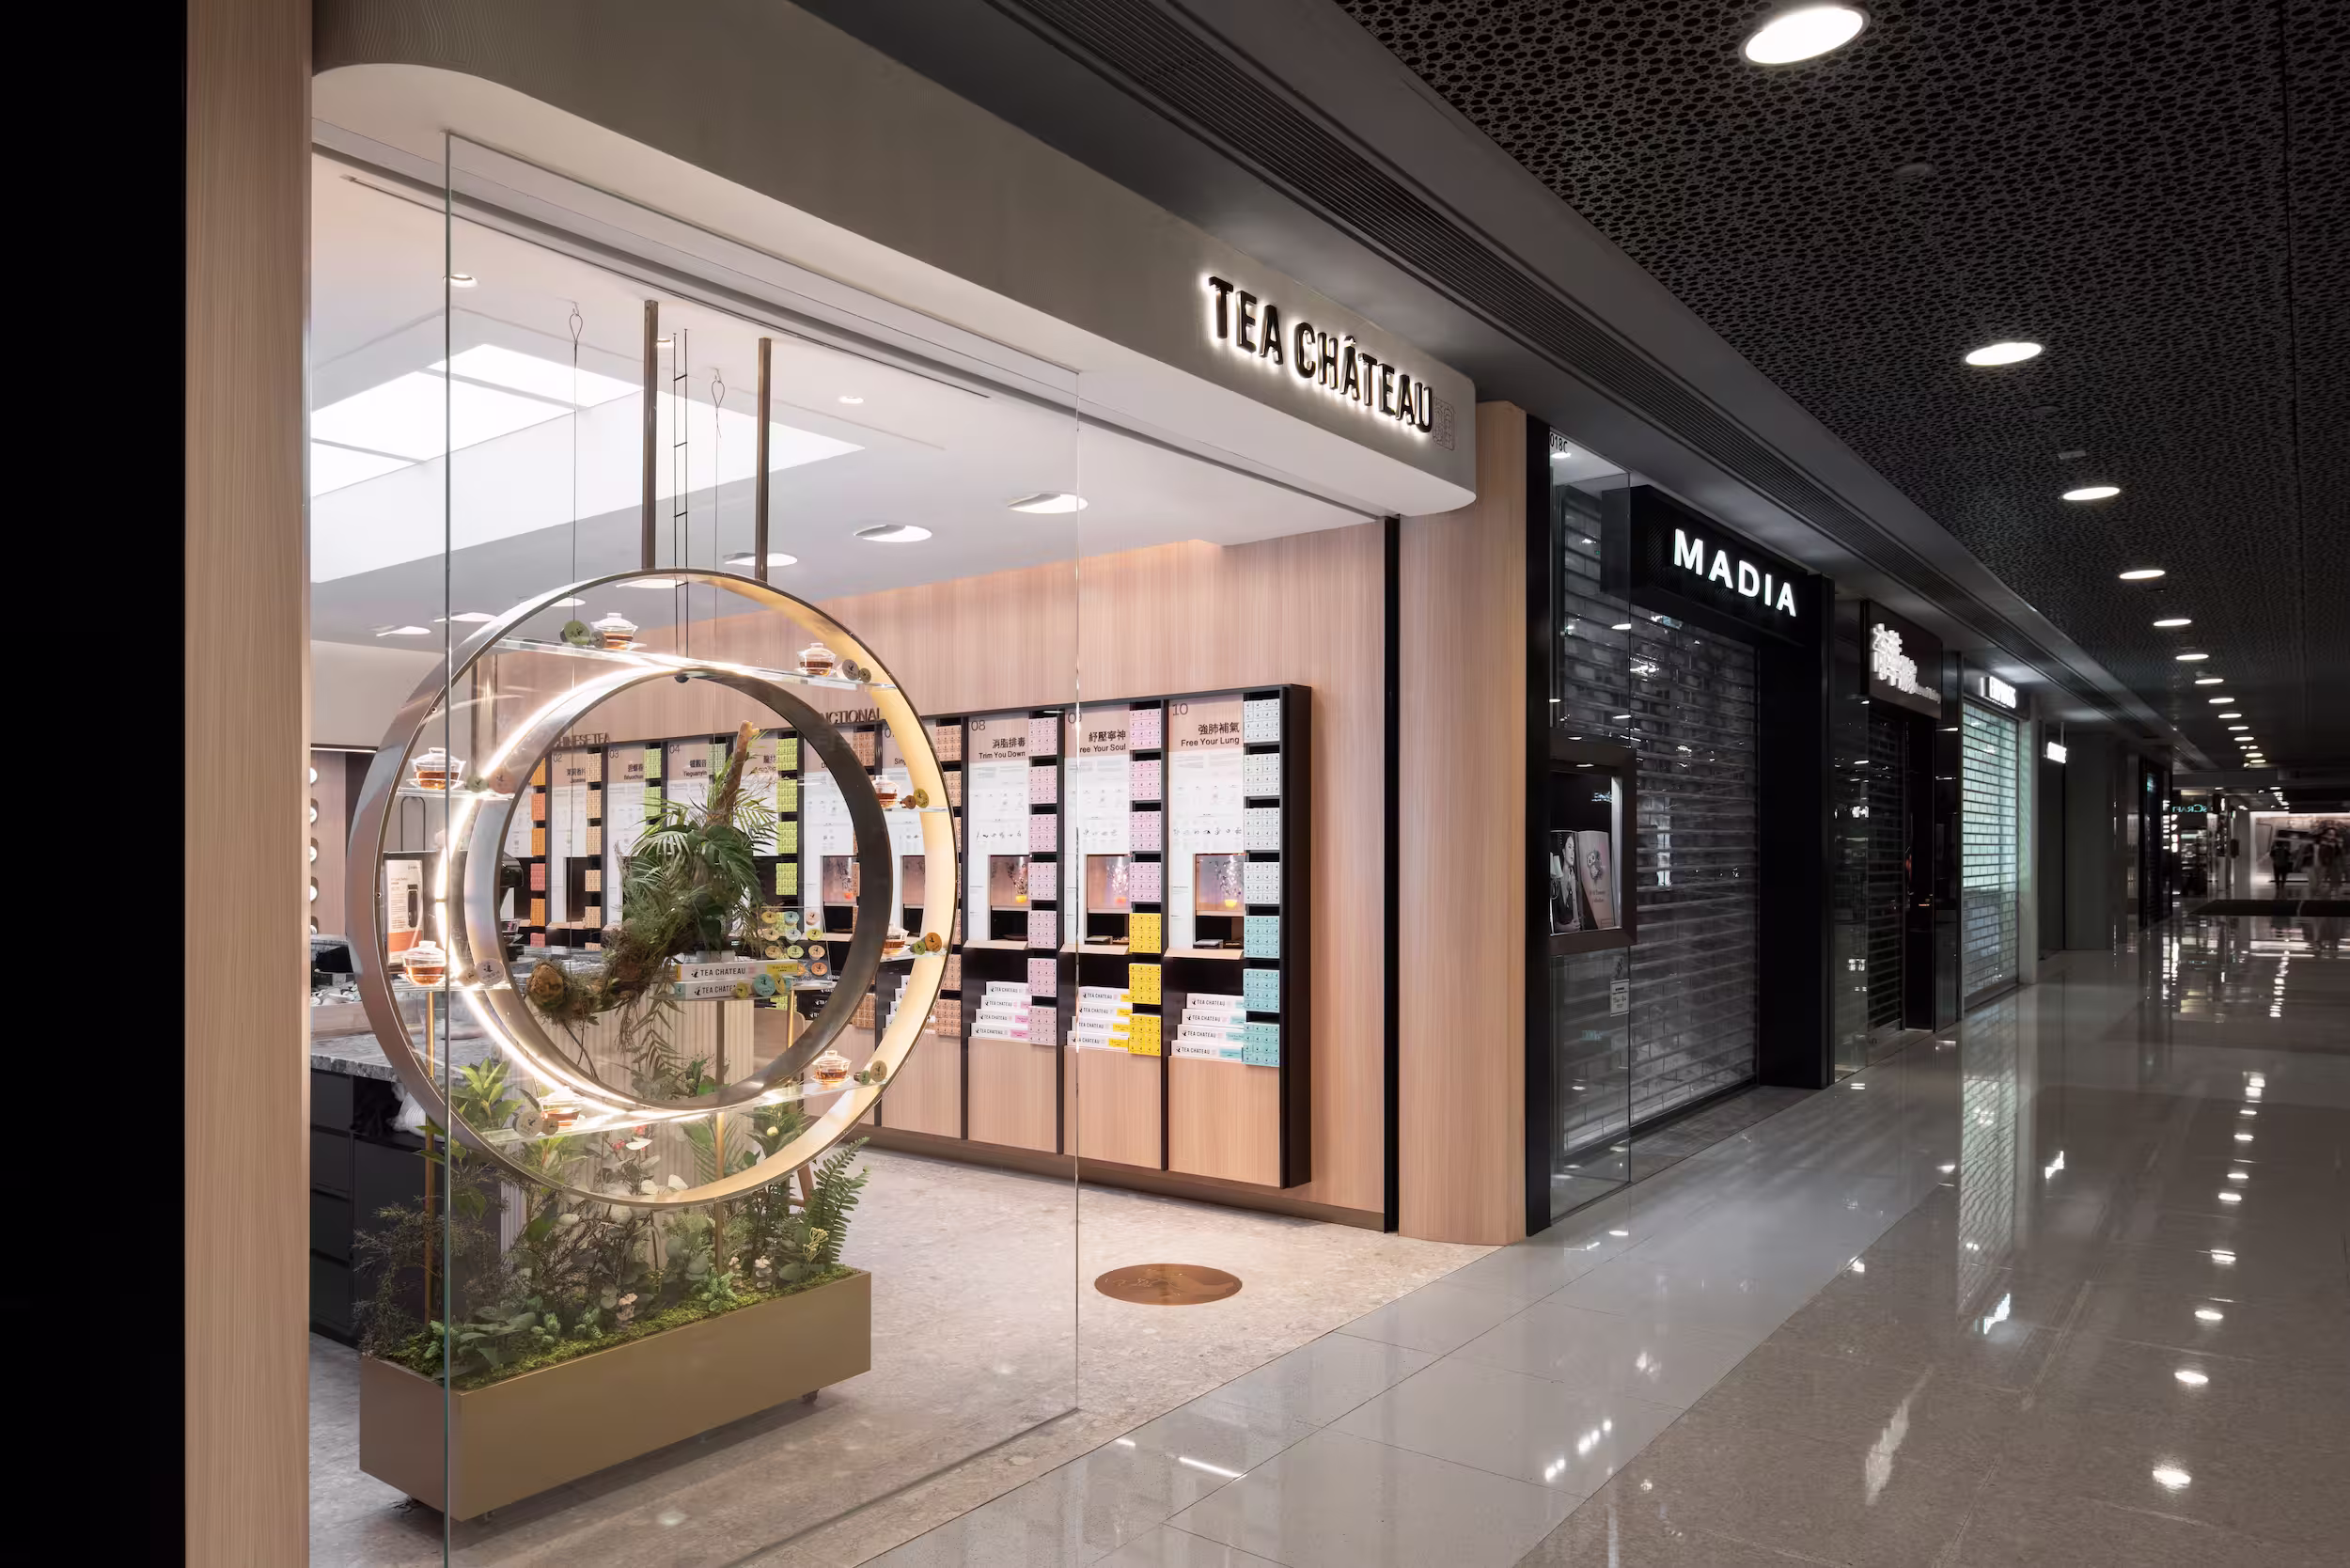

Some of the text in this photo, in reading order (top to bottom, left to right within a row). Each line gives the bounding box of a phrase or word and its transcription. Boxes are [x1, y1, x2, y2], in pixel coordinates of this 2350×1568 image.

[1208, 275, 1284, 366] TEA
[1293, 321, 1433, 433] CHÂTEAU
[1674, 527, 1797, 618] MADIA
[1172, 702, 1189, 716] 10
[822, 707, 880, 724] NCTIONAL
[971, 719, 986, 731] 08
[1198, 721, 1240, 736] 強肺補氣
[992, 736, 1026, 749] 消脂排毒
[1181, 736, 1240, 747] Free Your Lung
[608, 749, 619, 759] 03
[668, 744, 681, 755] 04
[1093, 745, 1109, 753] Your
[1109, 743, 1126, 752] Soul
[714, 967, 746, 976] CHATEAU
[702, 984, 736, 995] TEA CHATE
